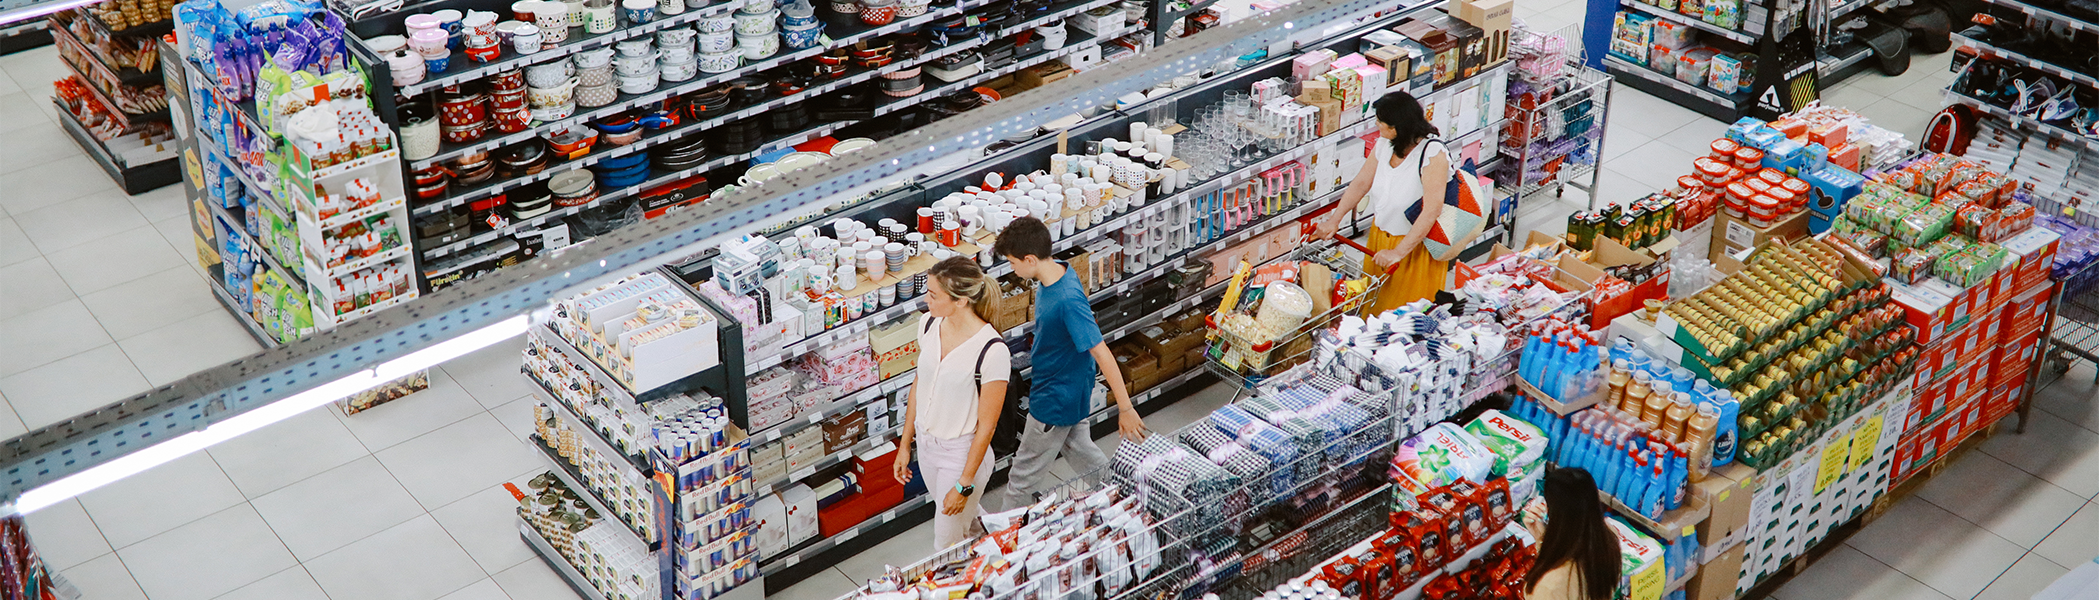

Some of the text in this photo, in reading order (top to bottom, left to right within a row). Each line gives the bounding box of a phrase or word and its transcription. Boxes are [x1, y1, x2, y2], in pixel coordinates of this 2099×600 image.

[1488, 416, 1533, 443] Persil
[1436, 431, 1470, 460] ARIEL
[690, 454, 715, 469] Red Bull
[692, 483, 716, 498] Red Bull
[695, 511, 720, 526] Red Bull
[698, 539, 723, 554] Red Bull
[702, 567, 726, 582] Red Bull
